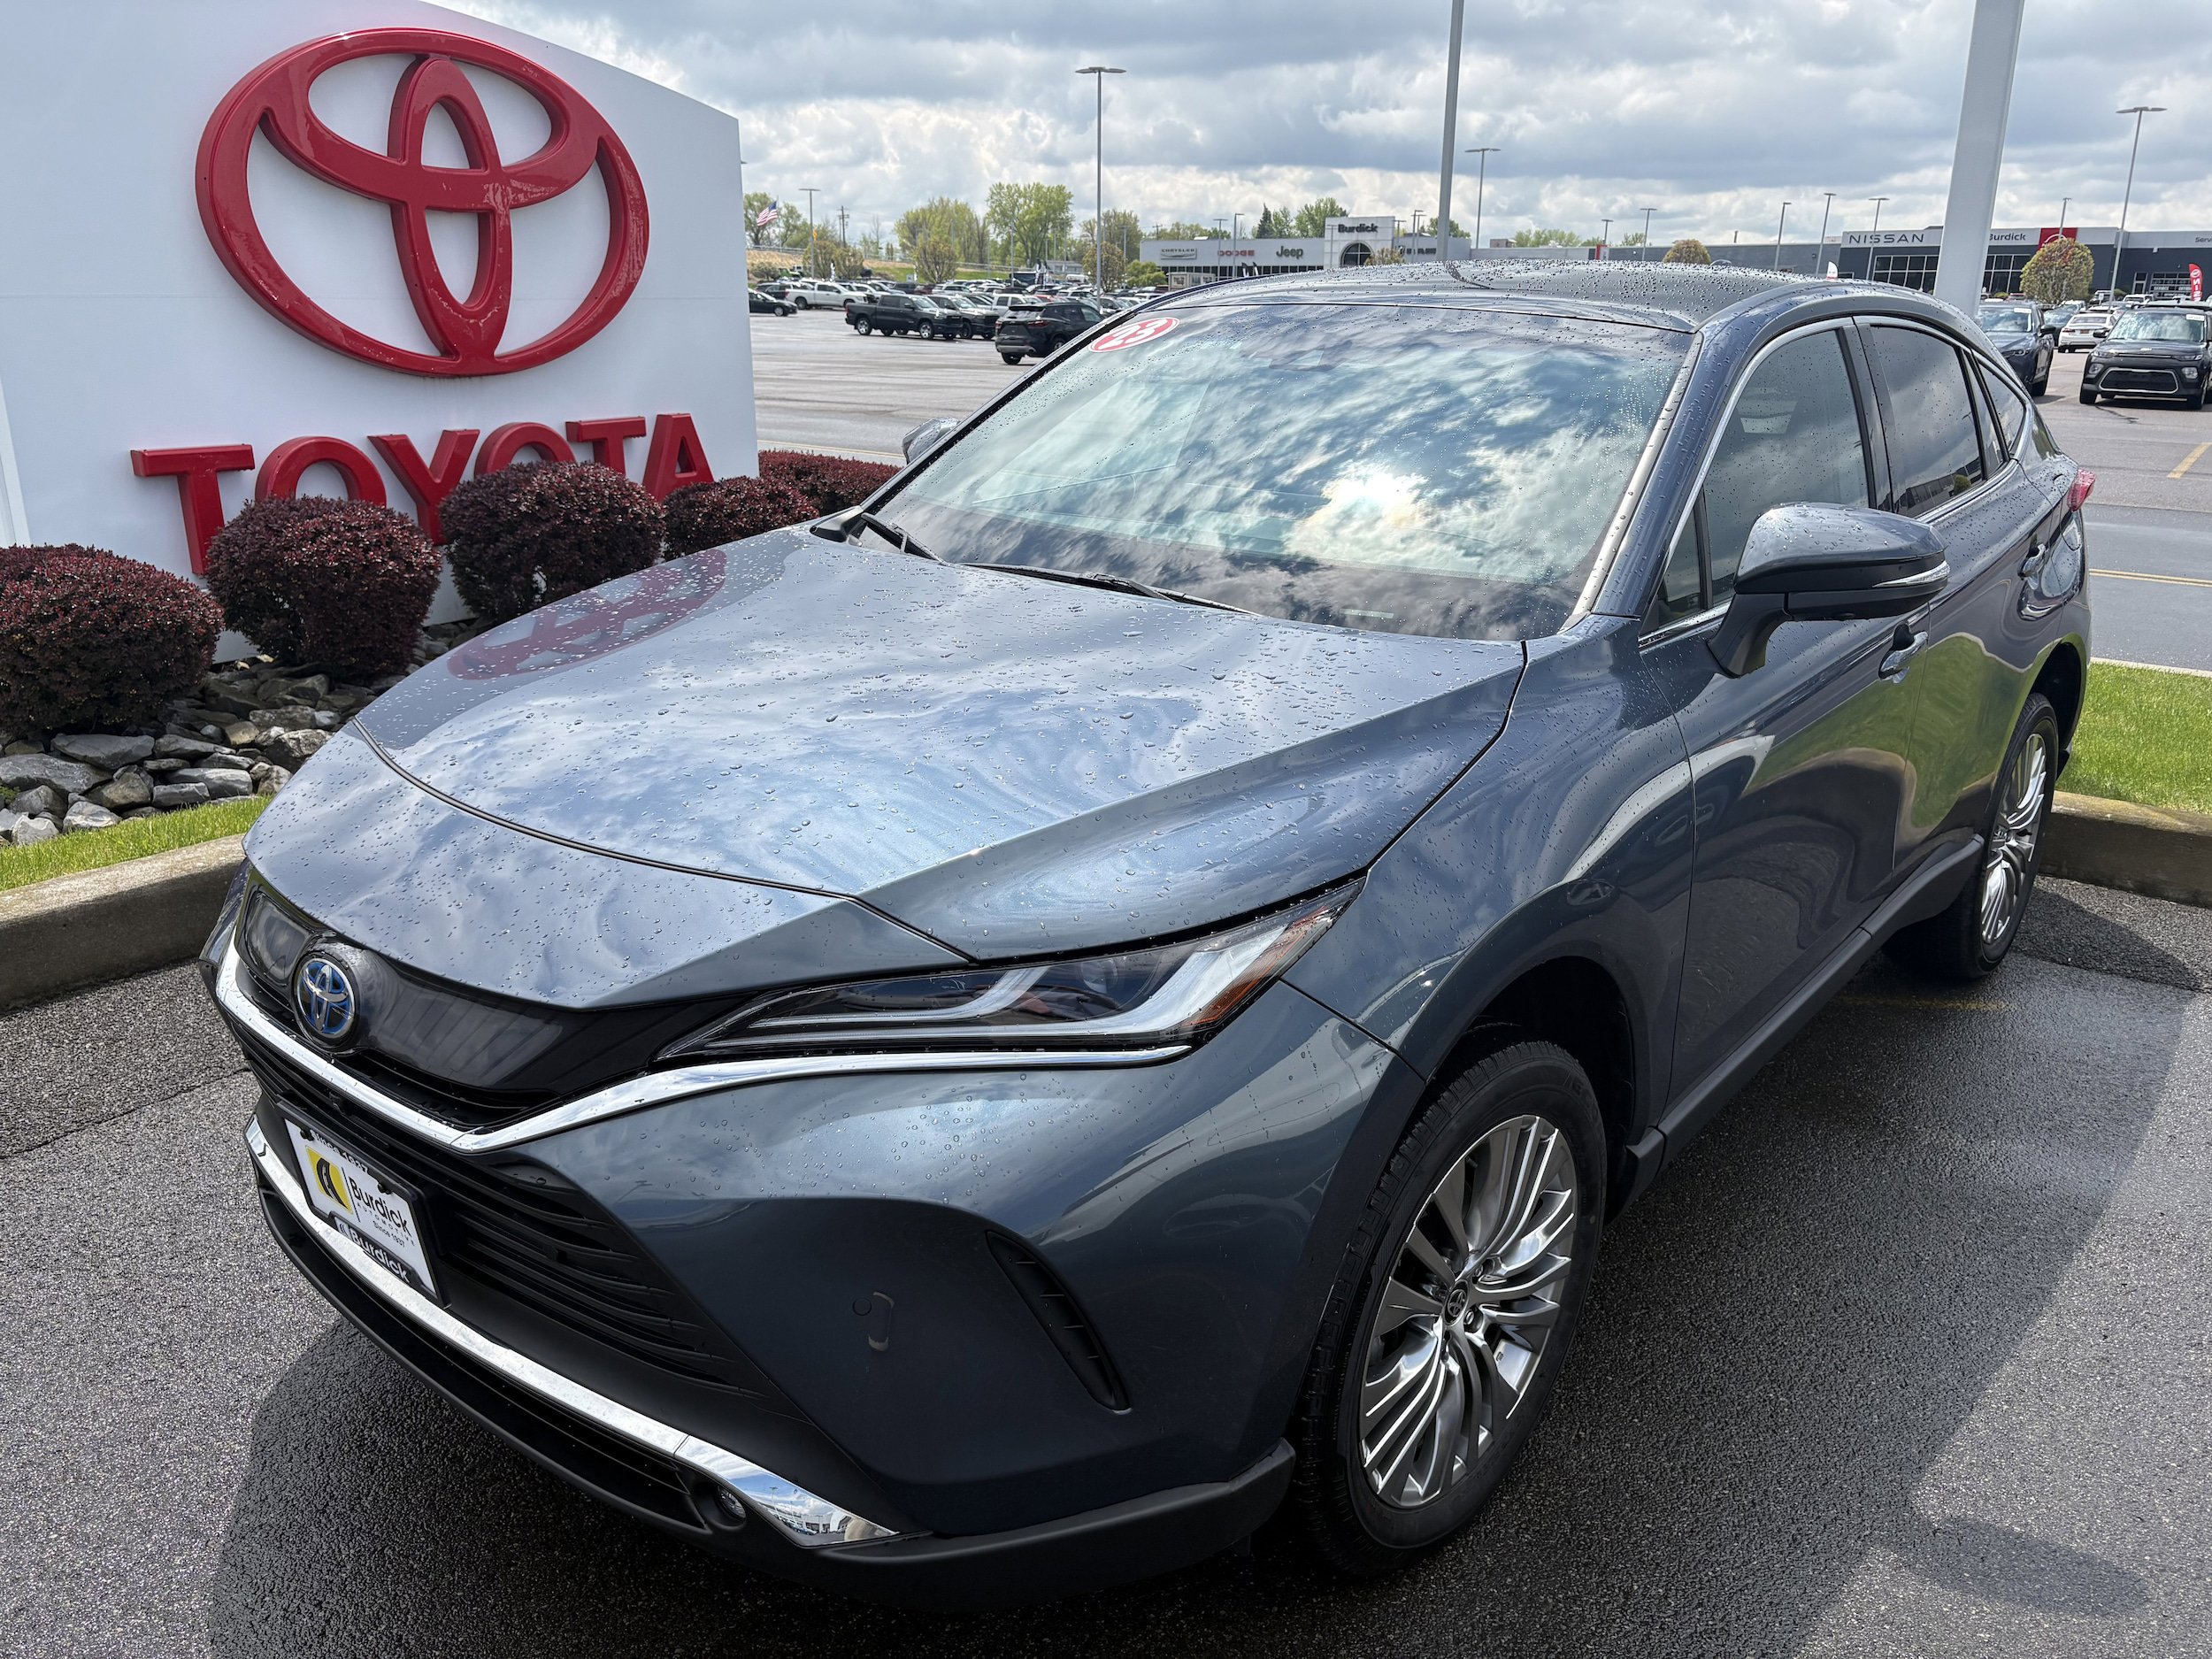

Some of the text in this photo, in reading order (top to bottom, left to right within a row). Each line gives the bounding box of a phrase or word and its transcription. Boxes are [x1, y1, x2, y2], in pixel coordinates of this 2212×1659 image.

[1338, 223, 1379, 234] Burdick
[1848, 234, 1924, 244] NISSAN
[1276, 246, 1304, 259] Jeep
[1097, 319, 1168, 349] 23
[349, 1176, 412, 1238] Burdick
[373, 1220, 391, 1238] Since
[349, 1227, 410, 1283] Burdick
